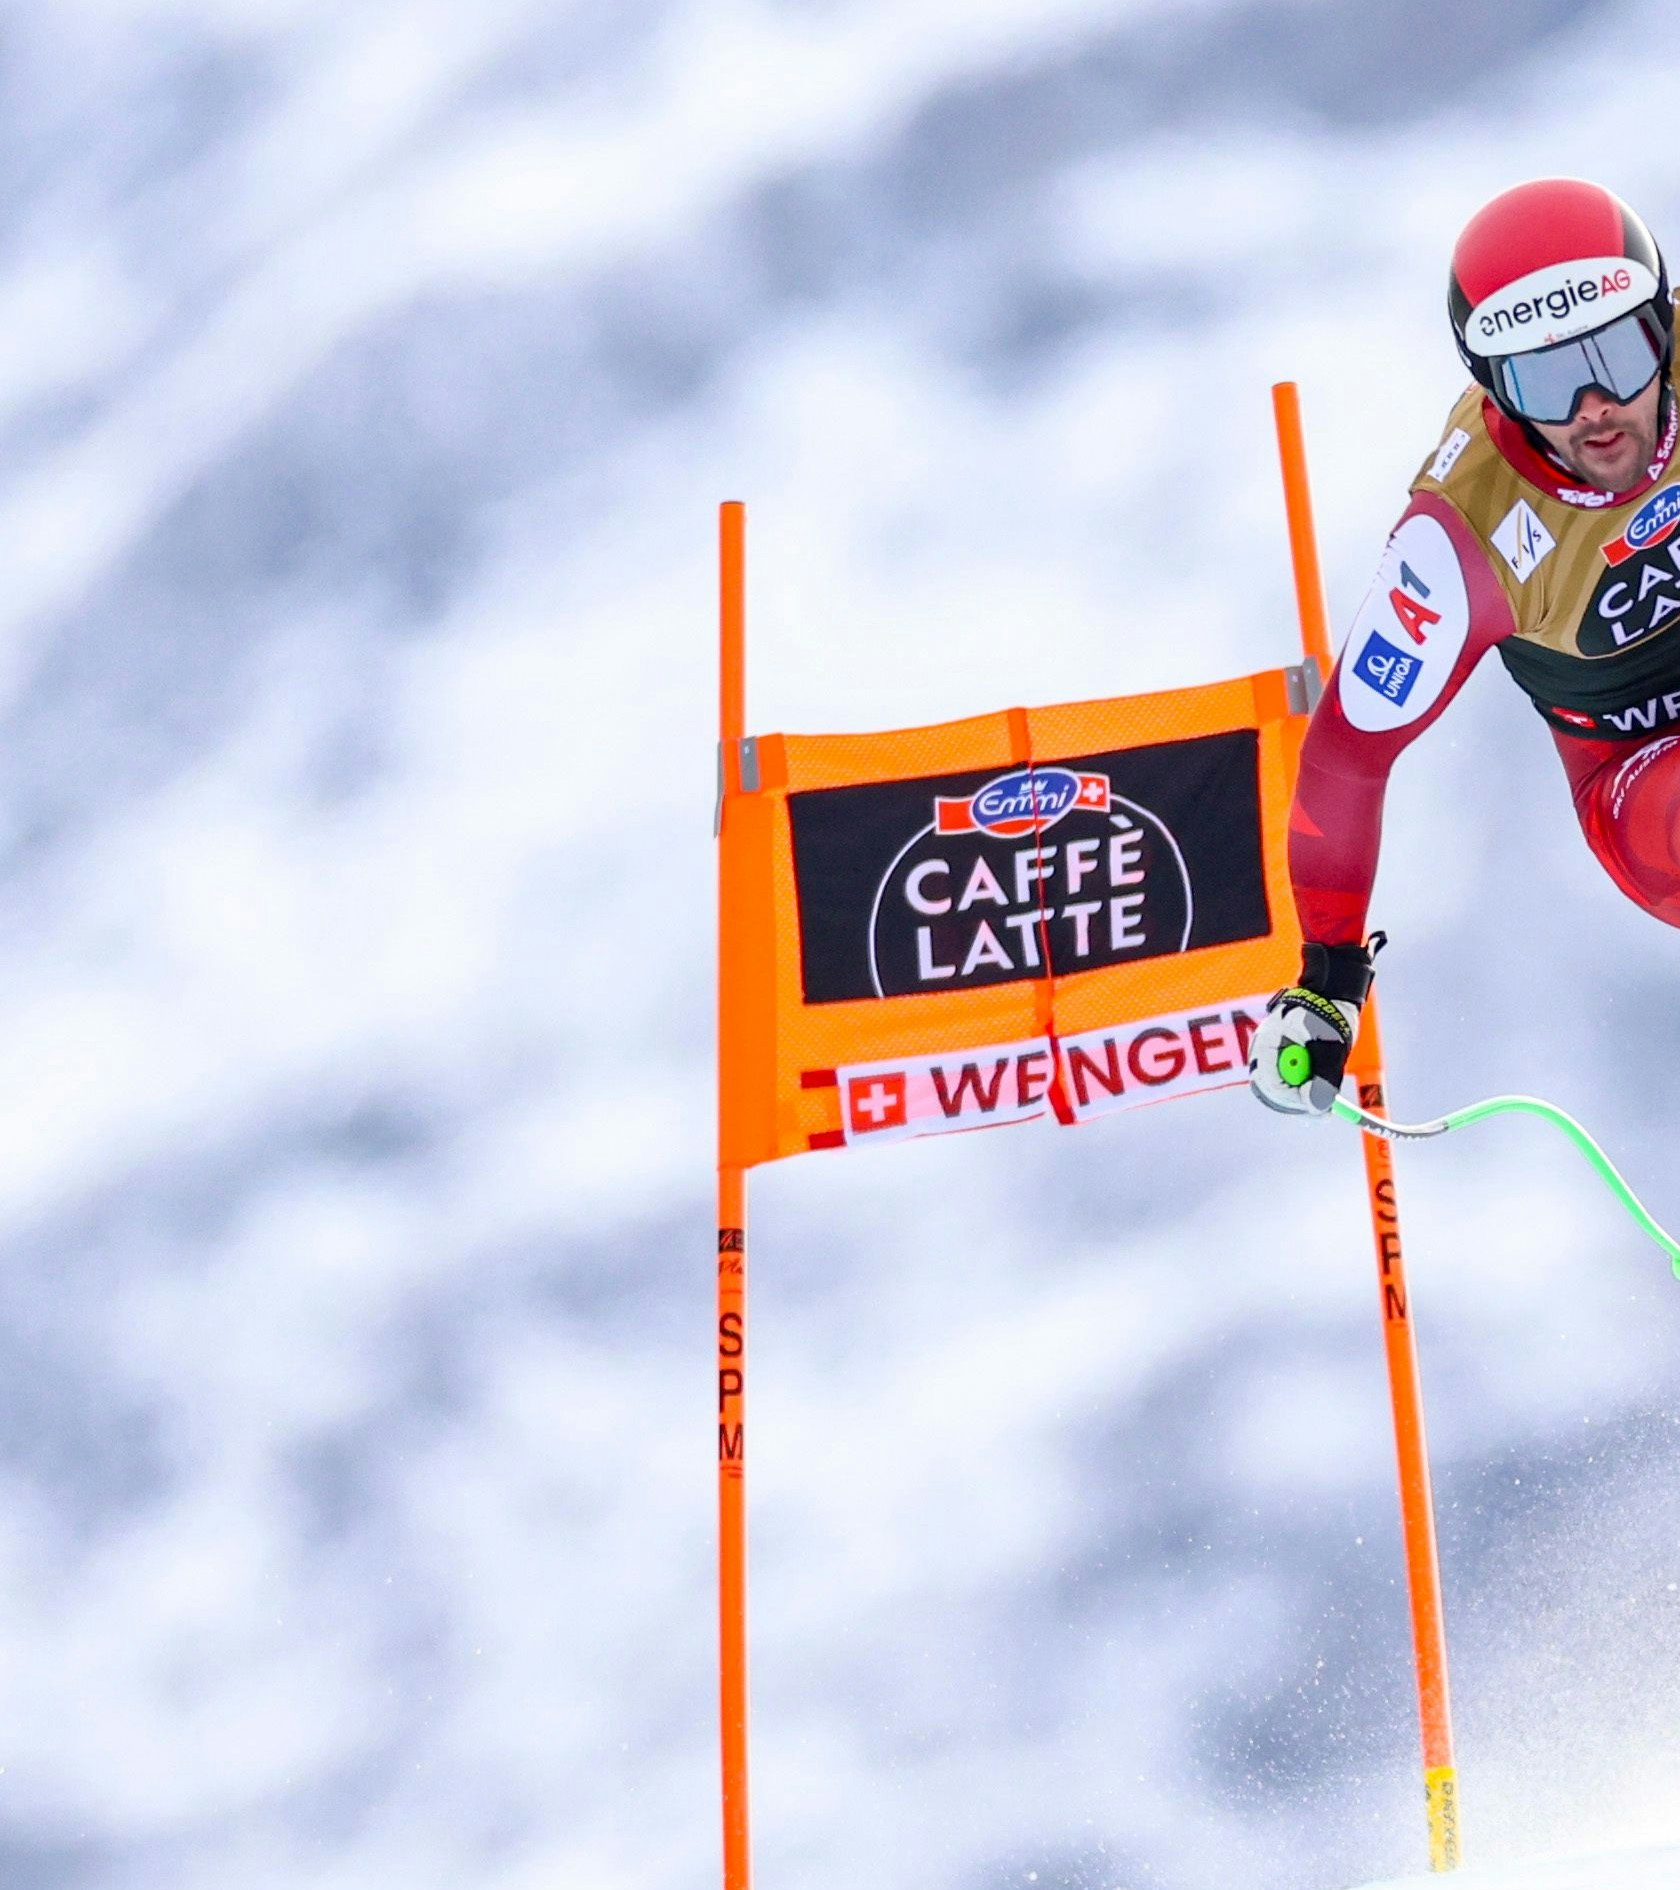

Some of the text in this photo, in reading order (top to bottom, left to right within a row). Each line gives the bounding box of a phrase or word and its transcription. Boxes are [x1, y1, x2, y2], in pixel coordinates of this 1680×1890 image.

[1389, 560, 1442, 646] A1
[1383, 656, 1415, 699] UNIQA
[978, 784, 1070, 817] Emmi
[904, 813, 1146, 916] CAFFÈ
[916, 892, 1147, 981] LATTE
[718, 1311, 745, 1461] SPM
